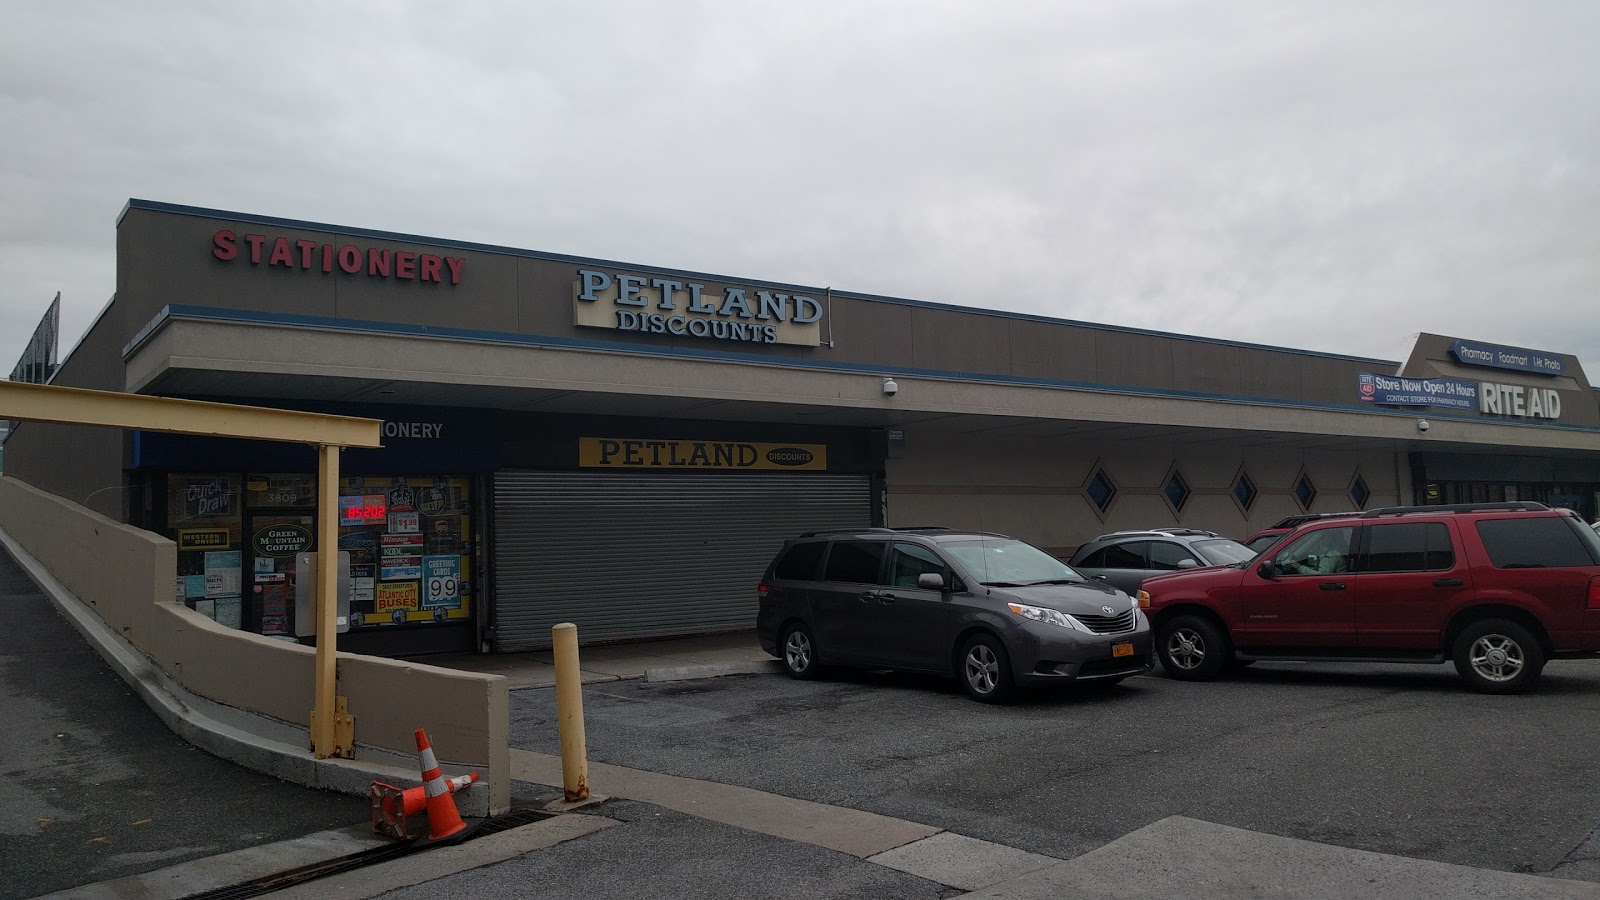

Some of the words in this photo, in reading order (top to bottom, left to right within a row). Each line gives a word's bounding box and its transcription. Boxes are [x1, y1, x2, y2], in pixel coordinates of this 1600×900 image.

[212, 230, 466, 284] STATIONERY
[577, 269, 823, 323] PETLAND
[617, 310, 777, 344] DISCOUNTS
[1461, 346, 1493, 363] Pharmacy
[1499, 352, 1528, 366] Foodmart
[1545, 360, 1561, 371] Photo
[1362, 384, 1372, 392] AID
[1375, 377, 1399, 391] Store
[1402, 380, 1421, 392] Now
[1423, 380, 1445, 397] Open
[1446, 382, 1455, 394] 24
[1456, 384, 1475, 398] Hours
[1387, 394, 1410, 402] CONTACT
[1410, 395, 1427, 403] STORE
[1437, 397, 1456, 405] PHARMACY
[1457, 399, 1470, 407] HOURS
[1480, 382, 1526, 416] RITE
[1529, 388, 1561, 419] AID
[381, 421, 443, 439] IONERY
[599, 440, 757, 468] PETLAND
[768, 451, 810, 462] DISCOUNTS
[187, 480, 222, 502] Quick
[198, 494, 229, 515] Draw
[268, 494, 297, 503] 3809
[348, 507, 362, 518] 85
[364, 506, 386, 517] 202
[260, 537, 305, 545] MOUNTAIN
[265, 544, 300, 552] COFFEE
[384, 547, 404, 555] KOOL
[428, 559, 455, 568] GREETING
[433, 568, 451, 576] CARDS
[379, 589, 404, 600] ATLANTIC
[404, 587, 417, 598] CITY
[379, 598, 417, 610] BUSES
